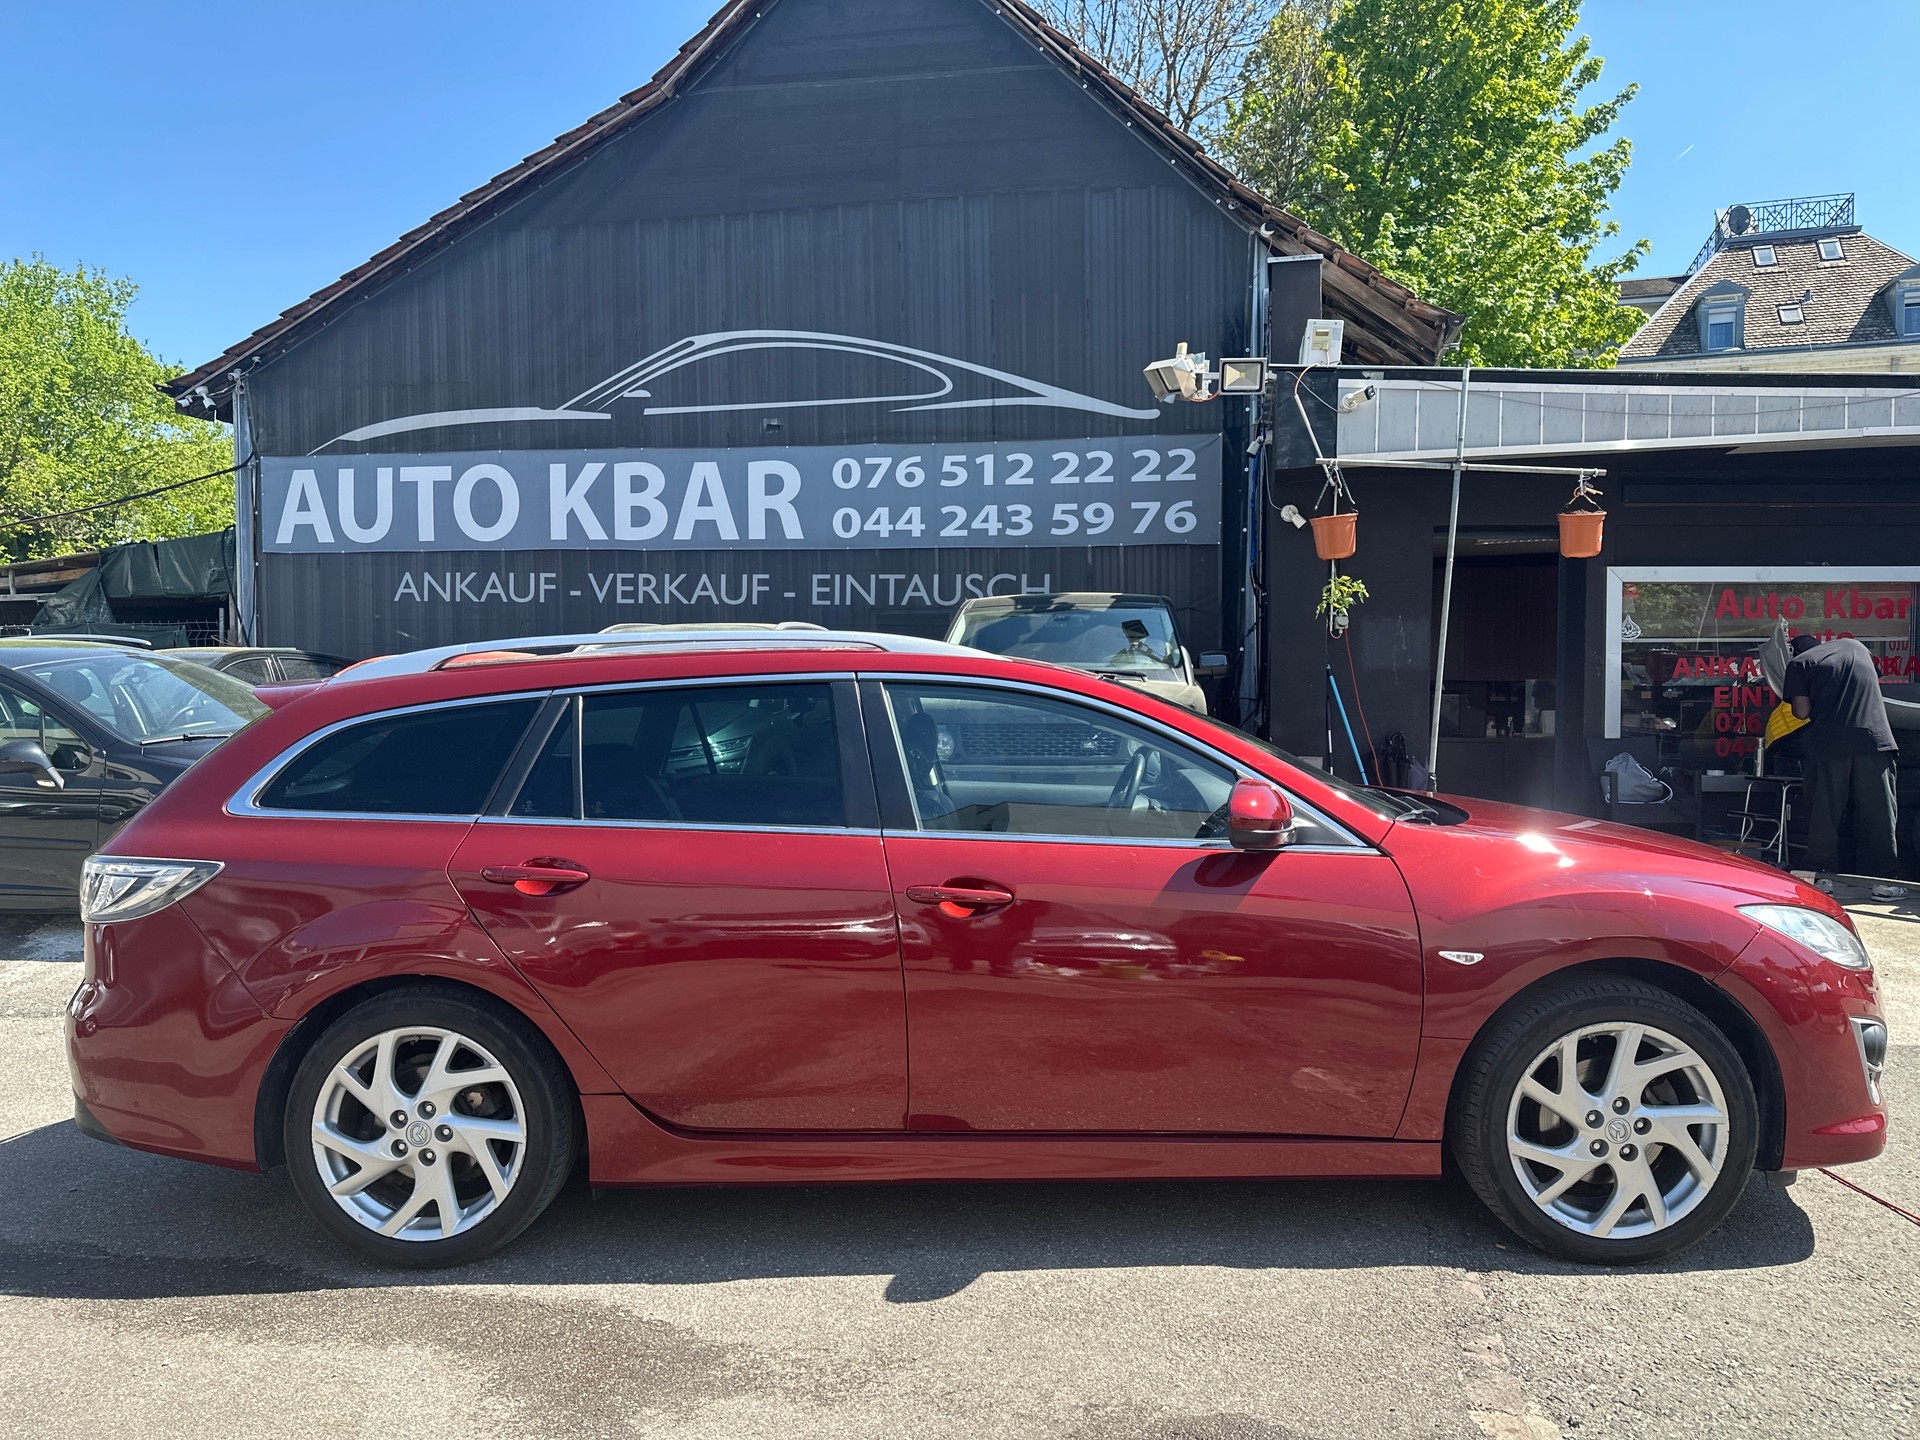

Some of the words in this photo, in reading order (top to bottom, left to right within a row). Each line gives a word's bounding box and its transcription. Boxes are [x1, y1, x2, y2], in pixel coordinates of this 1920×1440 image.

[832, 456, 926, 489] 076
[939, 453, 1034, 486] 512
[1050, 450, 1115, 484] 22
[1130, 448, 1197, 483] 22
[275, 463, 520, 544] AUTO
[549, 460, 805, 541] KBAR
[832, 506, 926, 539] 044
[939, 503, 1034, 537] 243
[1050, 501, 1115, 536] 59
[1130, 500, 1198, 534] 76
[394, 571, 557, 603] ANKAUF
[587, 573, 770, 605] VERKAUF
[811, 573, 1051, 606] EINTAUSCH
[1715, 589, 1806, 620] Auto
[1823, 588, 1914, 620] Kbar
[1715, 712, 1761, 733] 076
